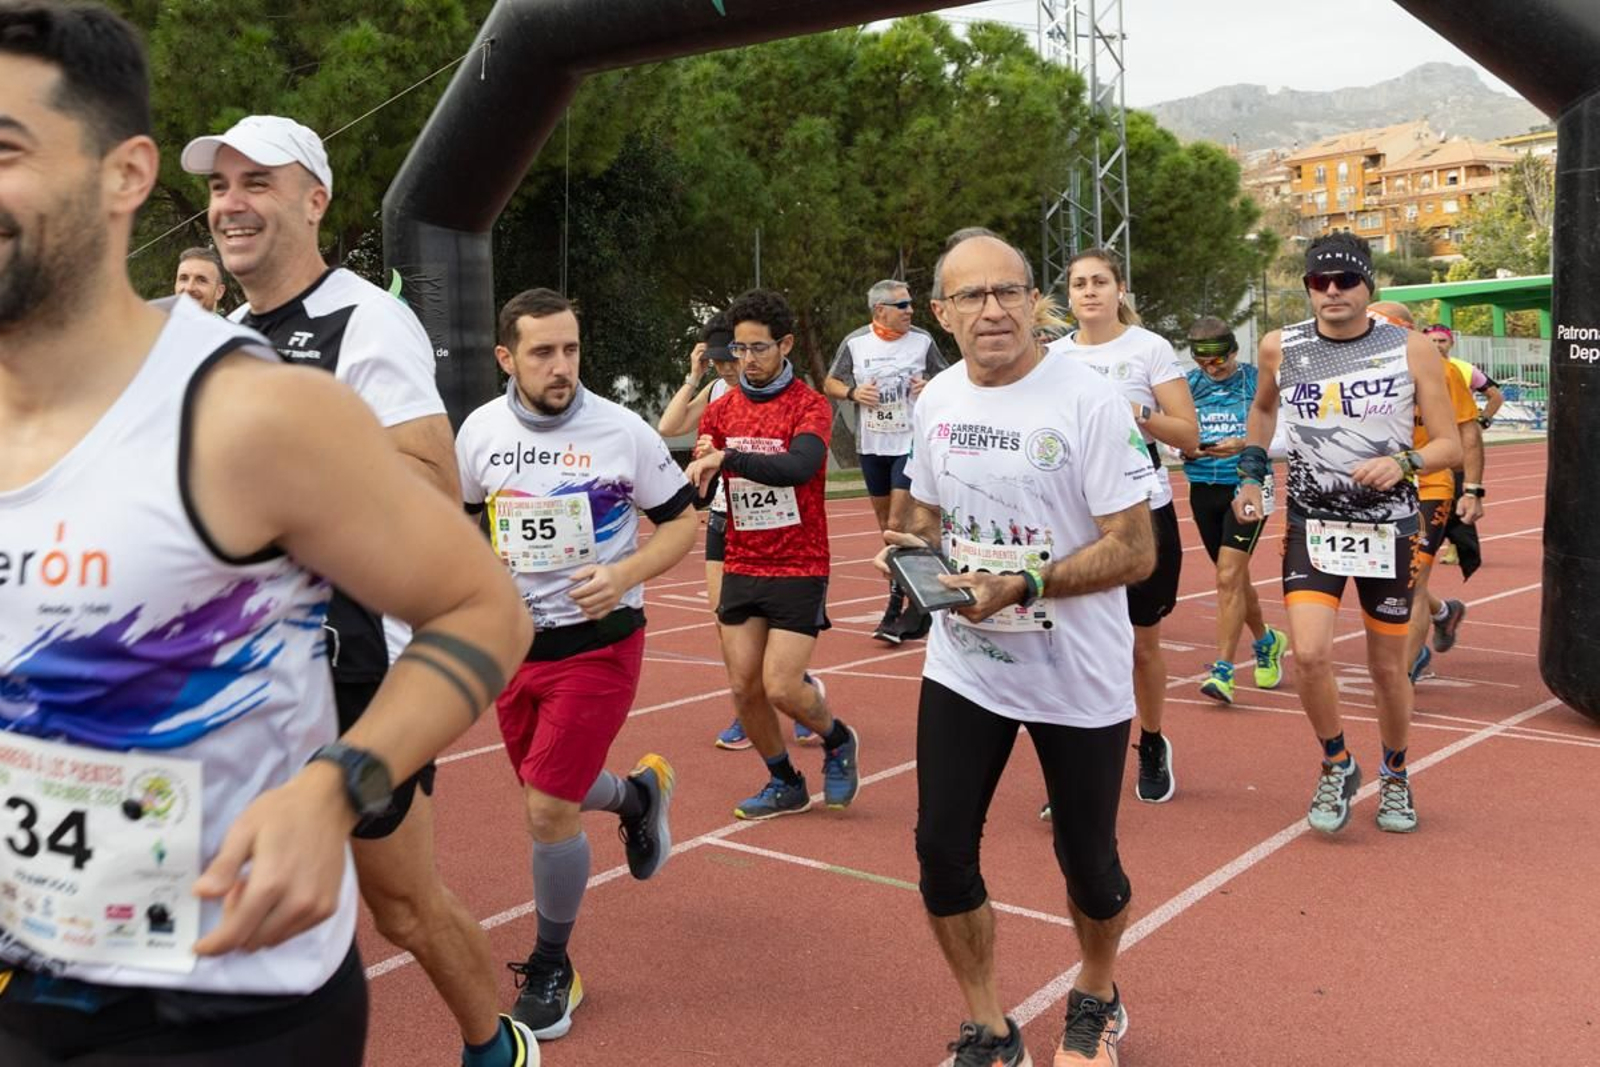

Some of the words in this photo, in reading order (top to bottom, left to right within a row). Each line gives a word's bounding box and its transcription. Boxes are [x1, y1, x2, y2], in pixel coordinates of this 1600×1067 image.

[1557, 324, 1600, 340] Patron
[436, 348, 449, 357] de
[1570, 343, 1600, 364] Dep
[1285, 378, 1398, 404] JABALCUZ
[877, 411, 893, 421] 84
[1200, 413, 1238, 423] MEDIA
[937, 423, 950, 437] 26
[951, 424, 993, 435] CARRERA
[1006, 430, 1020, 438] LOS
[950, 433, 1020, 451] PUENTES
[490, 441, 591, 474] calderón
[741, 490, 778, 508] 124
[522, 518, 557, 541] 55
[1325, 536, 1370, 554] 121
[5, 796, 93, 871] 34
